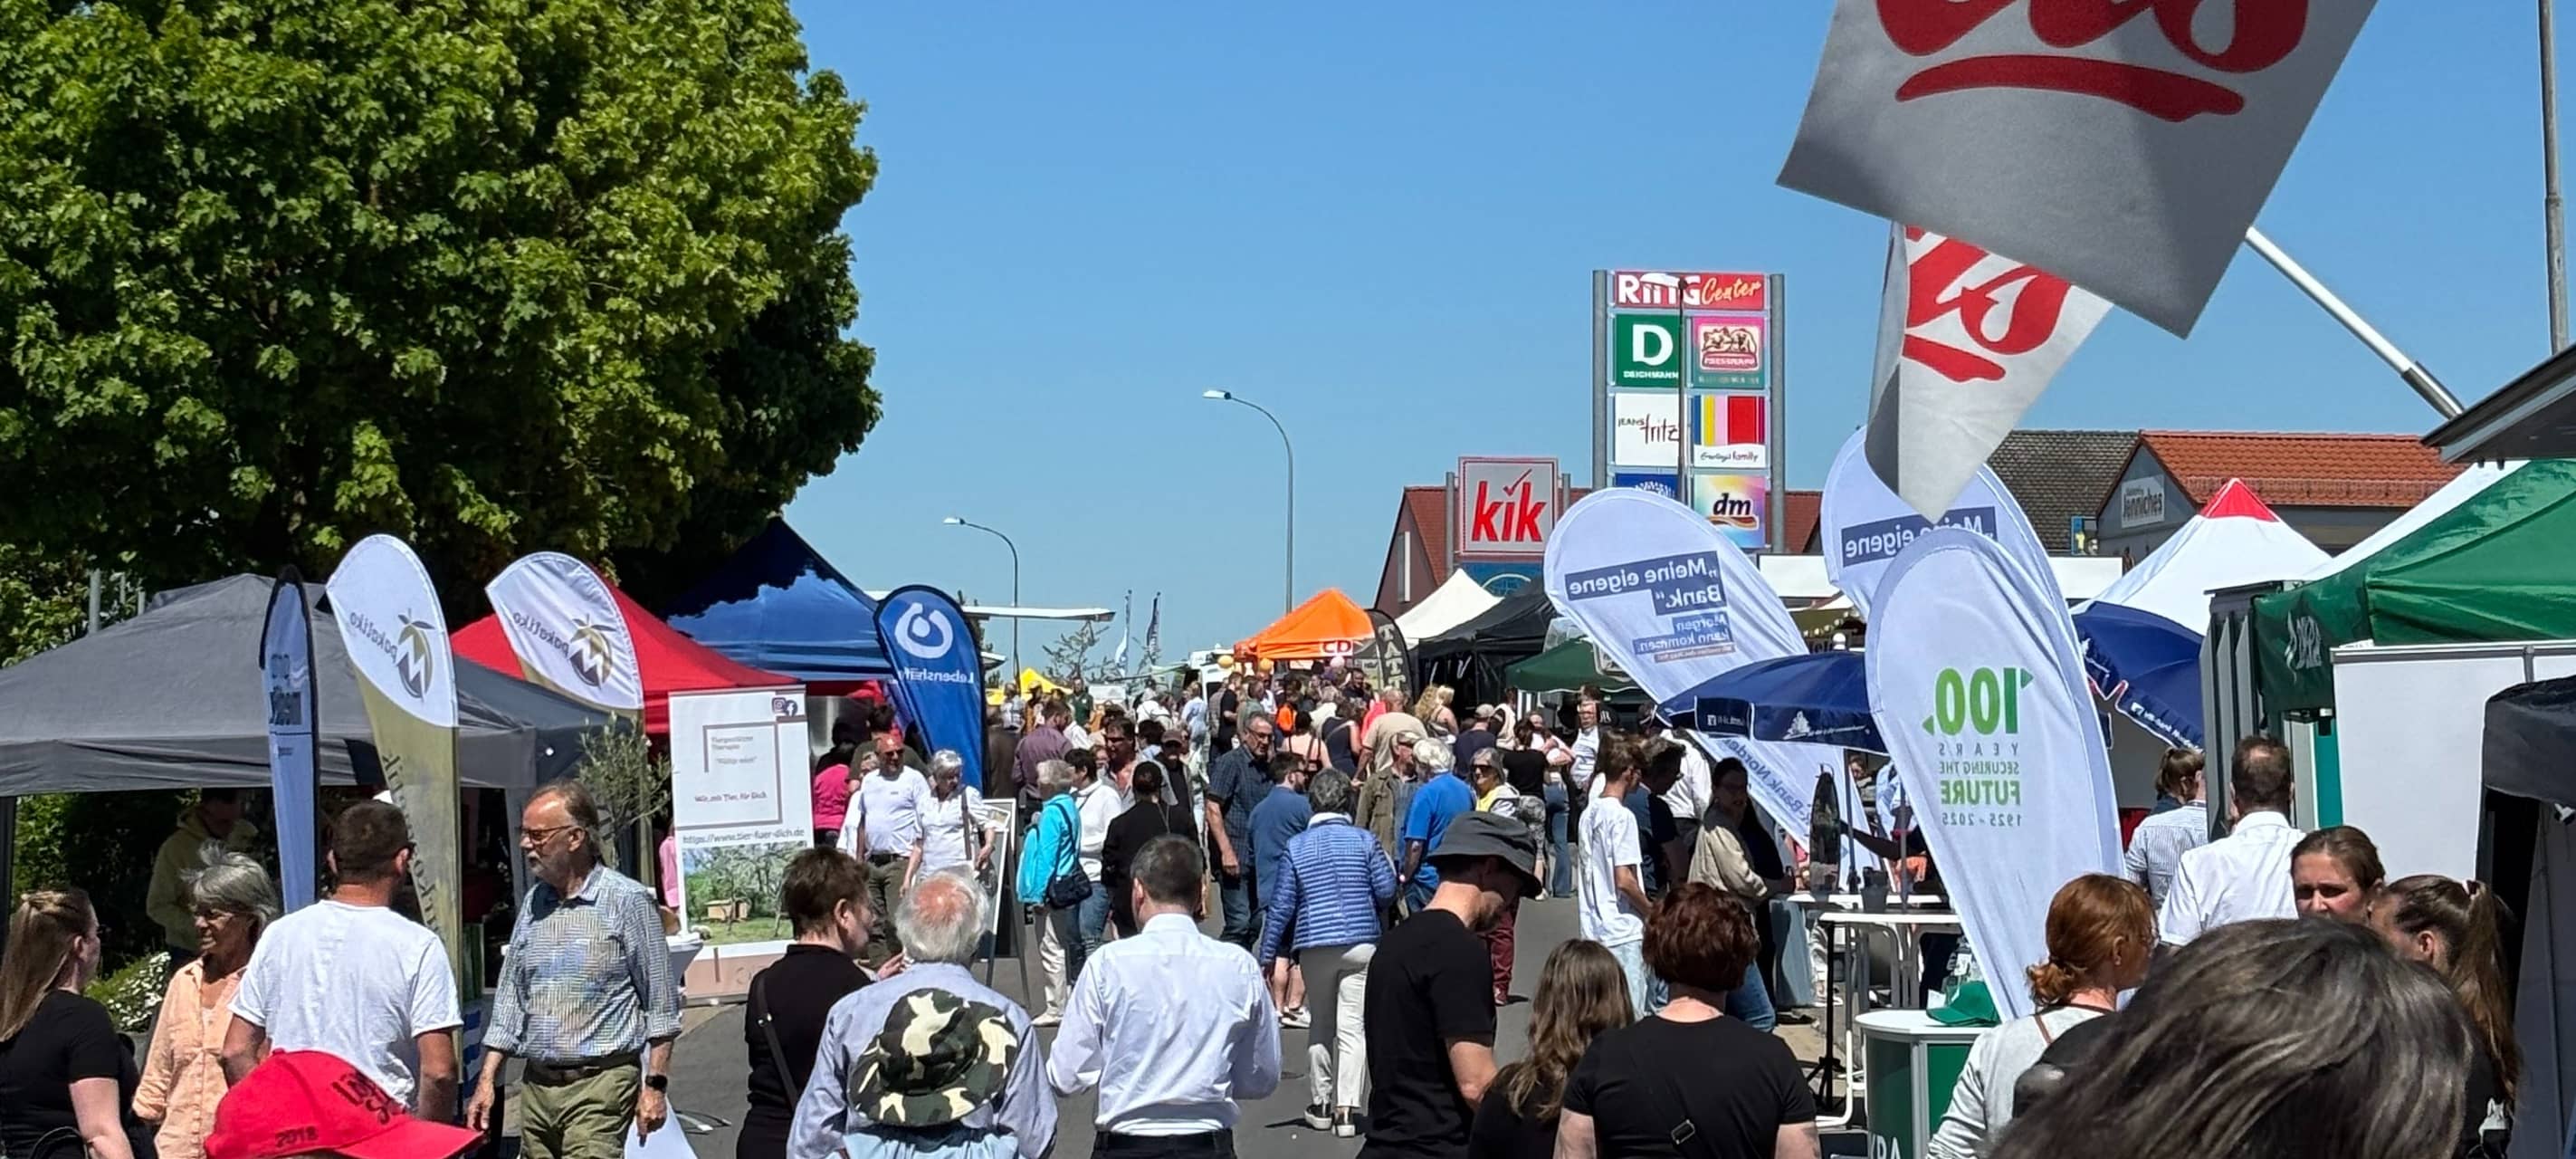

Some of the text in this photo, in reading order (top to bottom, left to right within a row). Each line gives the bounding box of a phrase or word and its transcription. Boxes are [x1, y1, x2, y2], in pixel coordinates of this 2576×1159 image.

[1701, 277, 1761, 305] Center
[1633, 324, 1674, 366] D
[1623, 370, 1679, 378] DEICHMANN
[1471, 469, 1547, 541] kik
[1713, 493, 1751, 515] dm
[1323, 640, 1352, 653] CD
[275, 1126, 319, 1148] 2018
